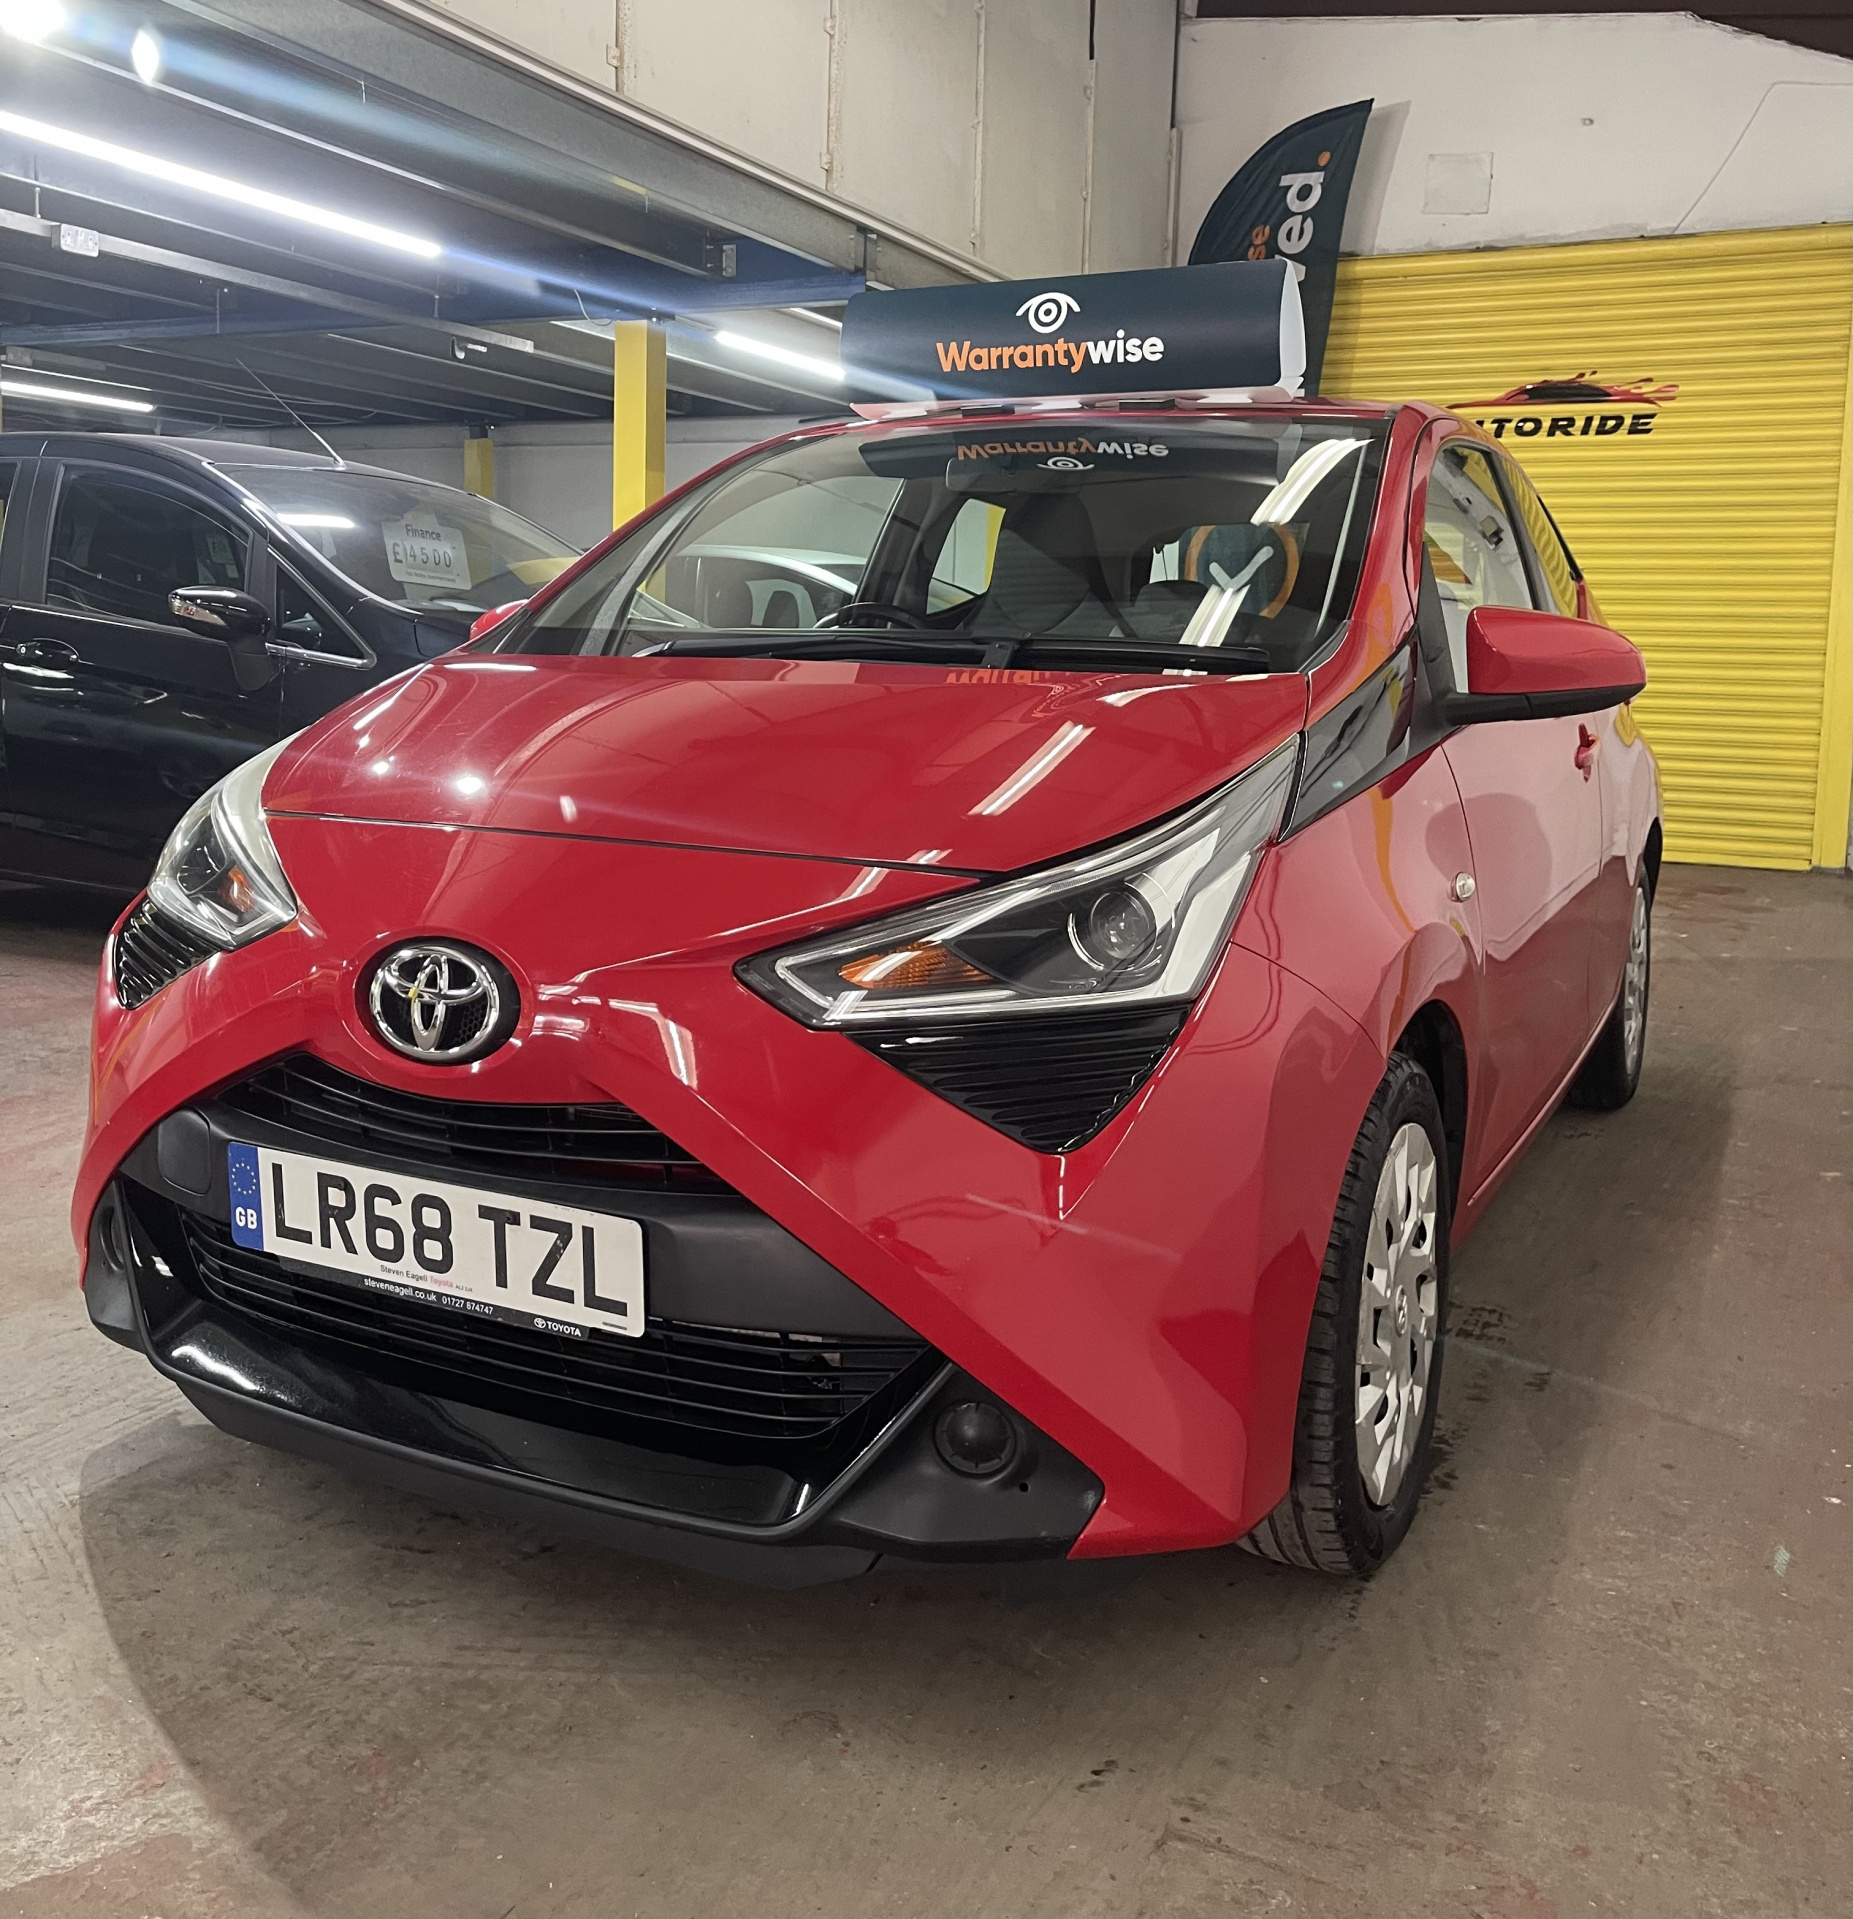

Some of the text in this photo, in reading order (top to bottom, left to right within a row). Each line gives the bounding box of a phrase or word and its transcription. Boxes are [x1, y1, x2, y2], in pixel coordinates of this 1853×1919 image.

[936, 329, 1164, 374] Warrantywise
[1475, 413, 1658, 438] TORIDE
[405, 524, 442, 541] Finance
[235, 1206, 258, 1230] GB
[271, 1162, 628, 1317] LR68 TZL
[380, 1264, 405, 1277] Steven
[405, 1270, 428, 1282] Eagell
[429, 1275, 454, 1288] Toyota
[363, 1277, 437, 1302] steveneagell.co.uk
[441, 1295, 465, 1308] 01727
[546, 1321, 582, 1337] TOYOTA
